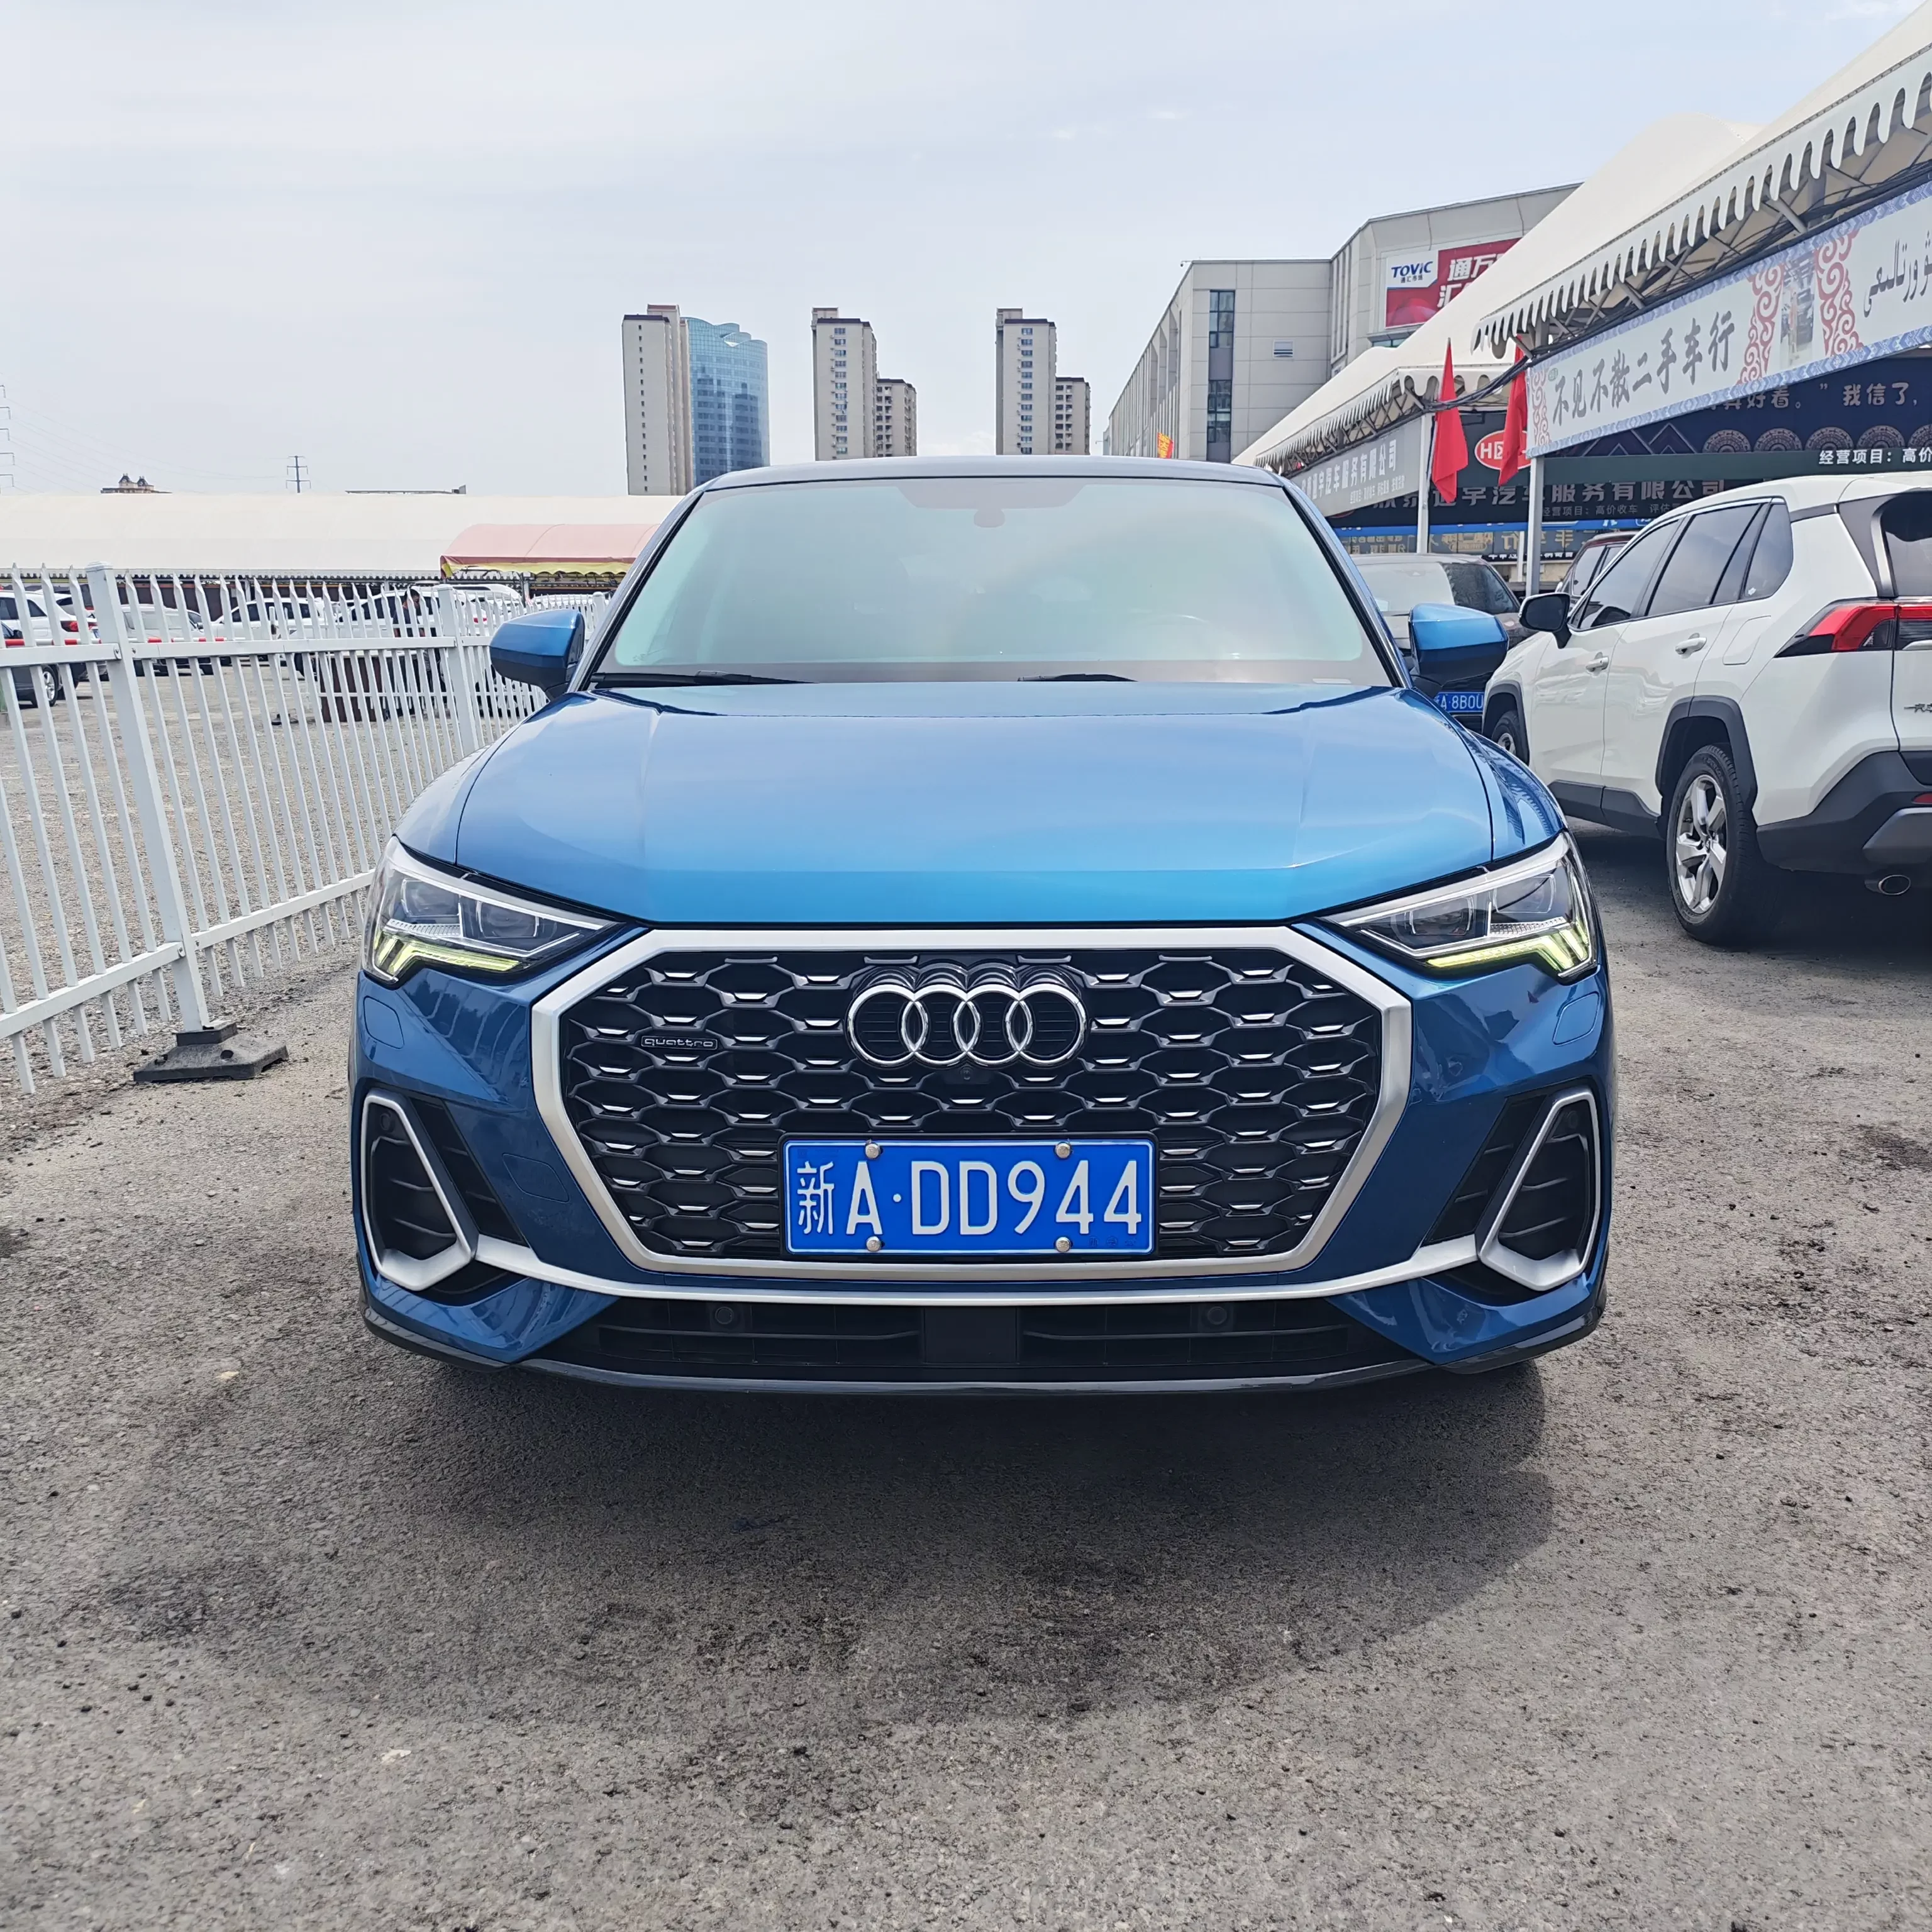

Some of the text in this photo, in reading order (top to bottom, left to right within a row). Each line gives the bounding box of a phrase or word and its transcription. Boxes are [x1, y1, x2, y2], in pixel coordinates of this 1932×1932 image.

[1447, 253, 1504, 282] 通万
[1437, 282, 1473, 308] 汇
[1553, 311, 1735, 426] 不见不散二手车行
[644, 1038, 713, 1047] quattro
[797, 1160, 1142, 1235] 新A·DD944
